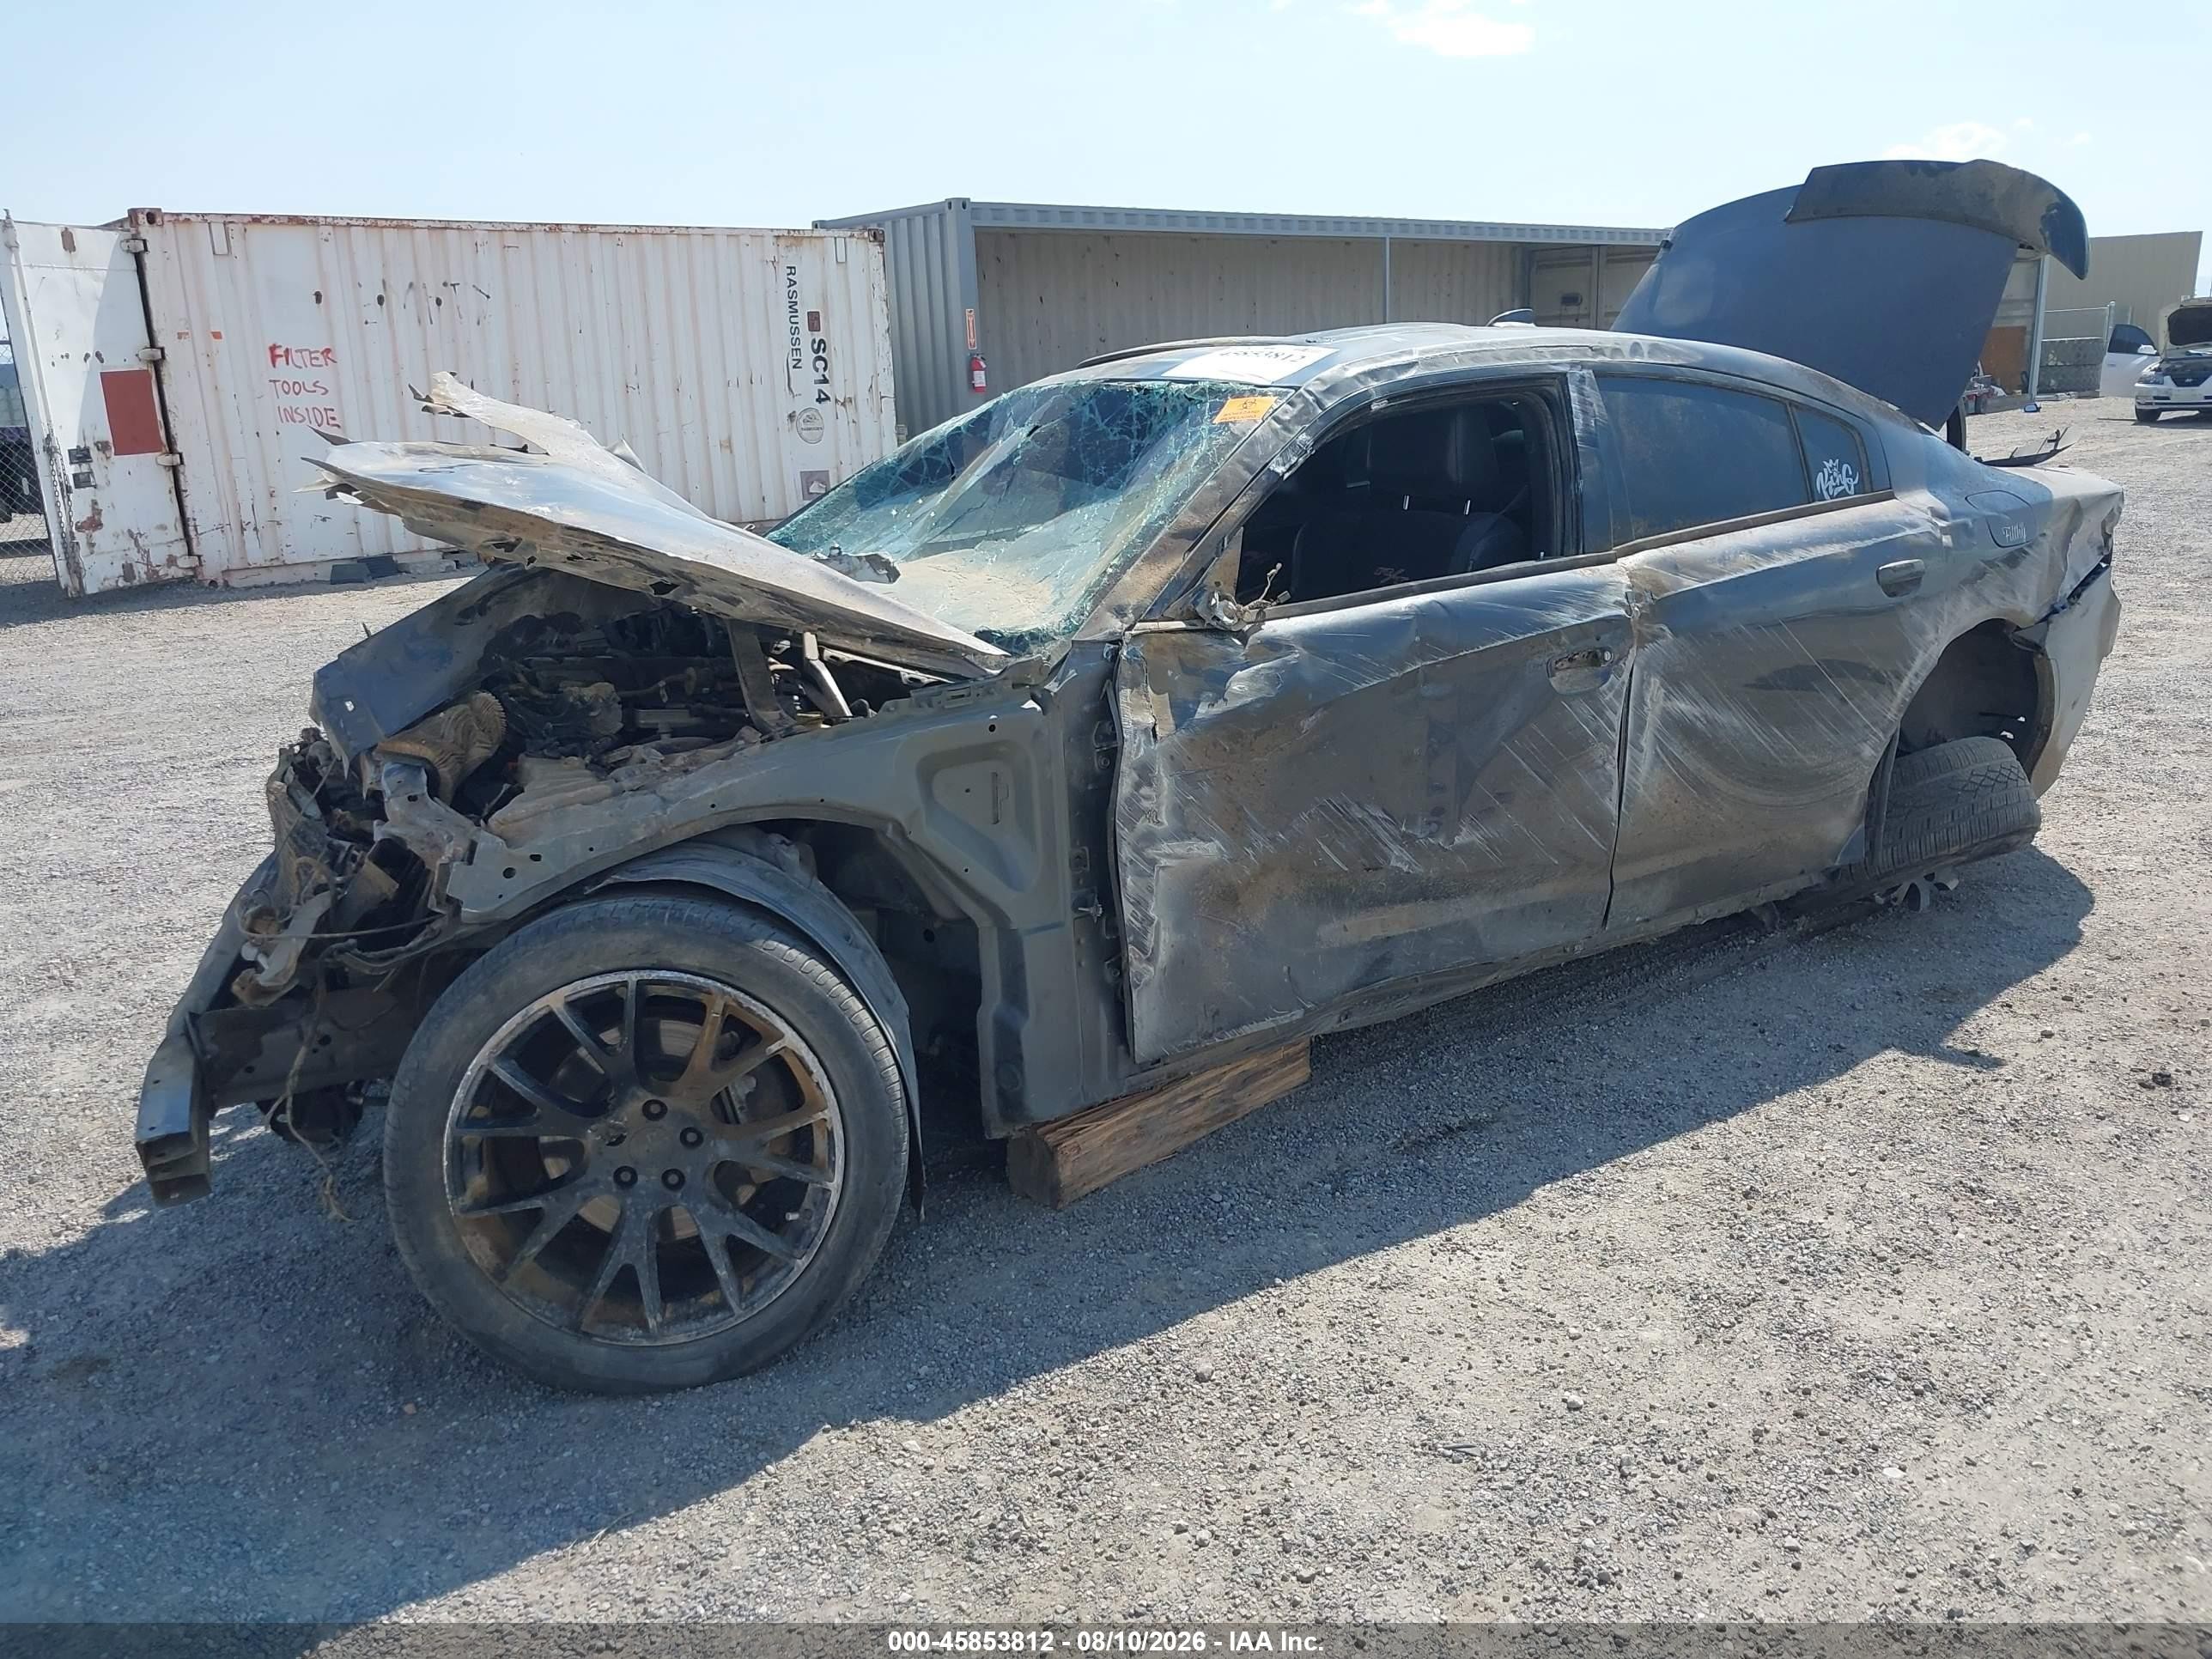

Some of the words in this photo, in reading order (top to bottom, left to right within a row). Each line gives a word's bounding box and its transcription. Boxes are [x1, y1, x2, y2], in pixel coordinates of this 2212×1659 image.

[786, 265, 803, 370] RASMUSSEN
[269, 343, 337, 369] FILTER
[811, 337, 831, 404] SC14
[268, 379, 329, 398] TOOLS
[277, 404, 341, 428] INSIDE
